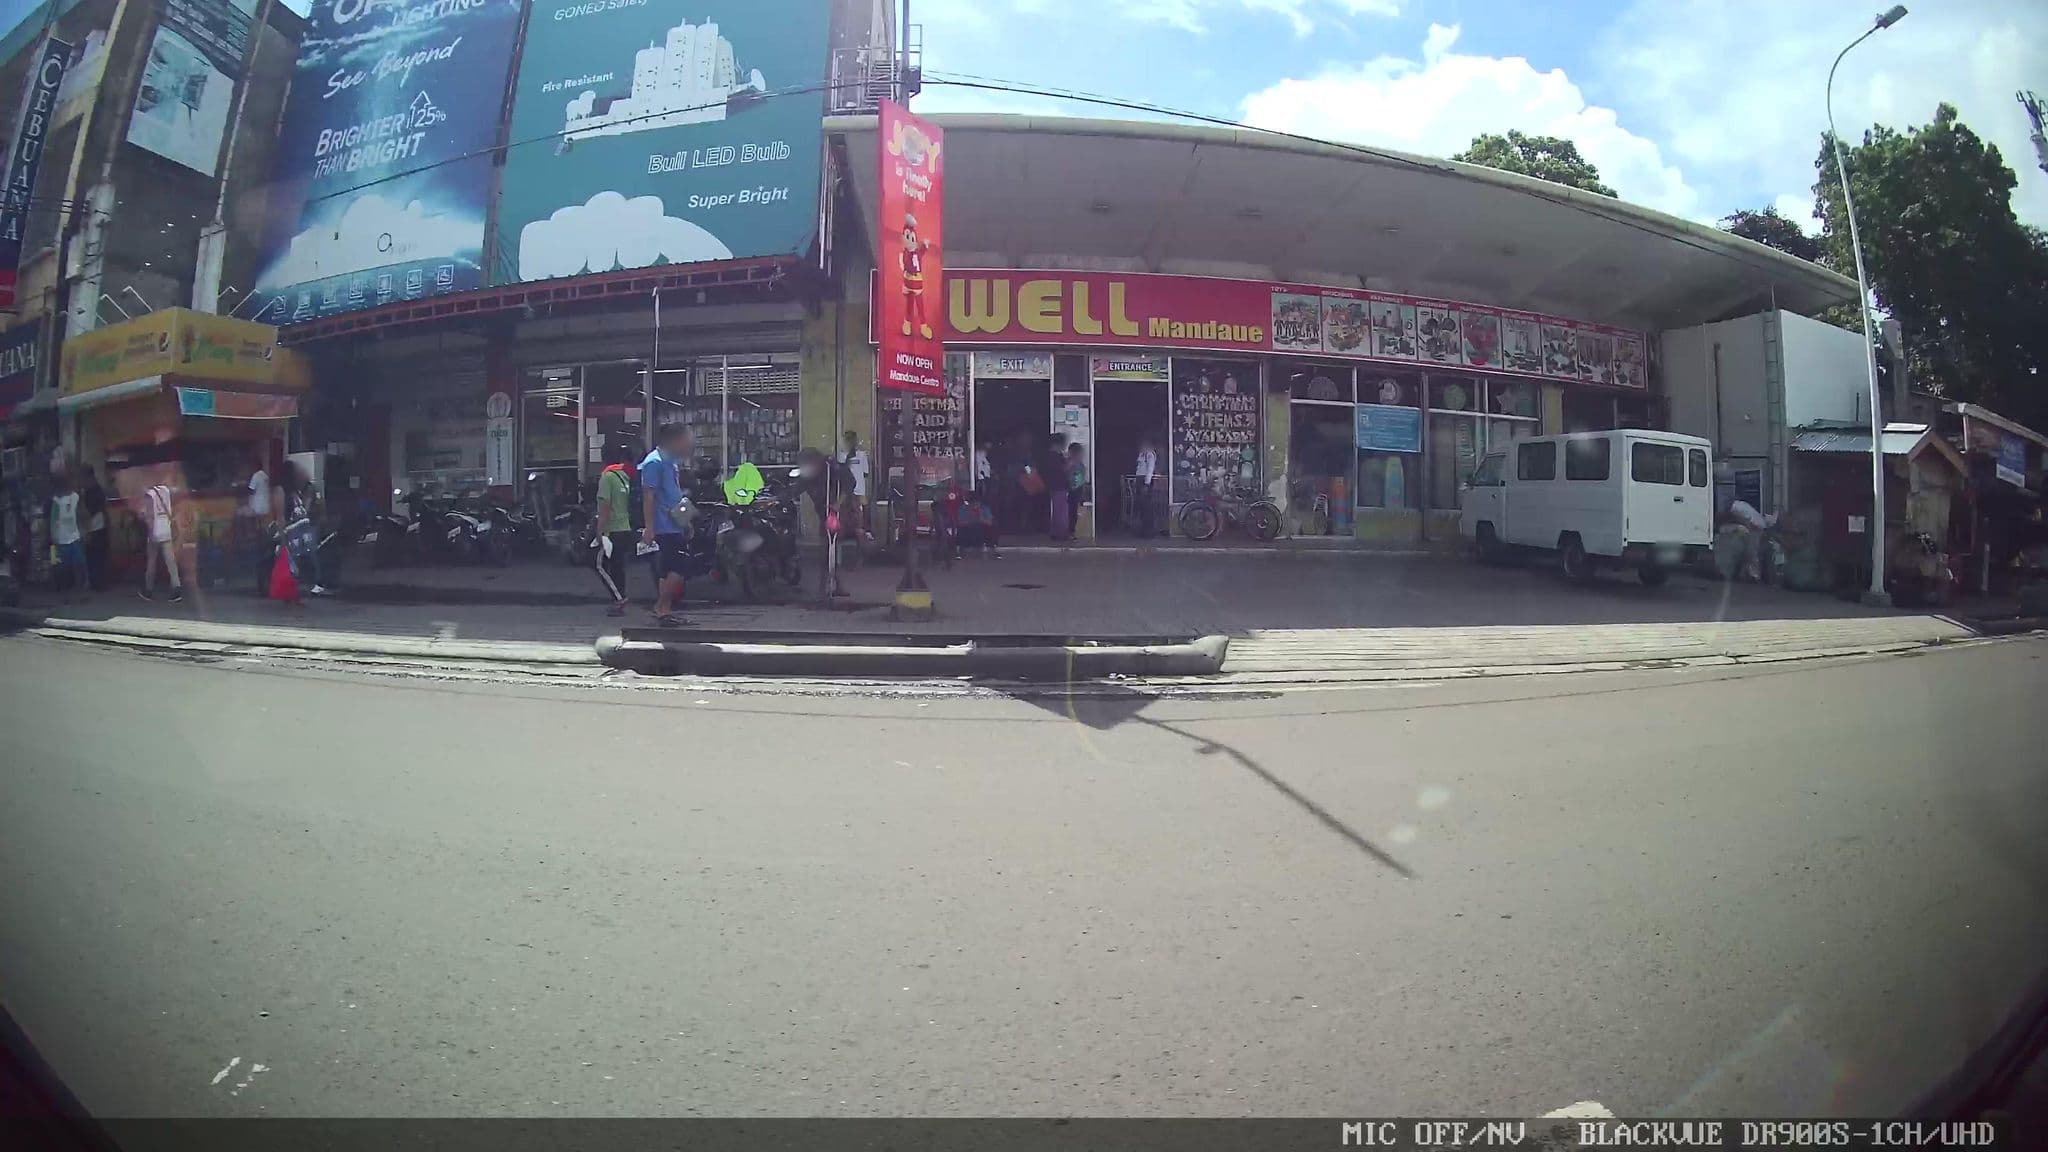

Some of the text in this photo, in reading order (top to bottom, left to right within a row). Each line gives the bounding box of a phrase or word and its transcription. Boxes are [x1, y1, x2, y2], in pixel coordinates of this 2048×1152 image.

[323, 37, 463, 99] See Beyond
[542, 72, 614, 93] Fire Resistant
[3, 55, 62, 241] CEBUANA
[314, 131, 426, 179] THAN BRIGHT
[648, 141, 791, 174] Bull LED Bulb
[688, 185, 789, 210] Super Bright
[949, 278, 1264, 343] WELL Mandaue
[896, 353, 933, 370] NOW OPEN
[1001, 358, 1025, 371] EXIT
[1109, 361, 1153, 372] ENTRANCE
[890, 369, 920, 384] Mandaue
